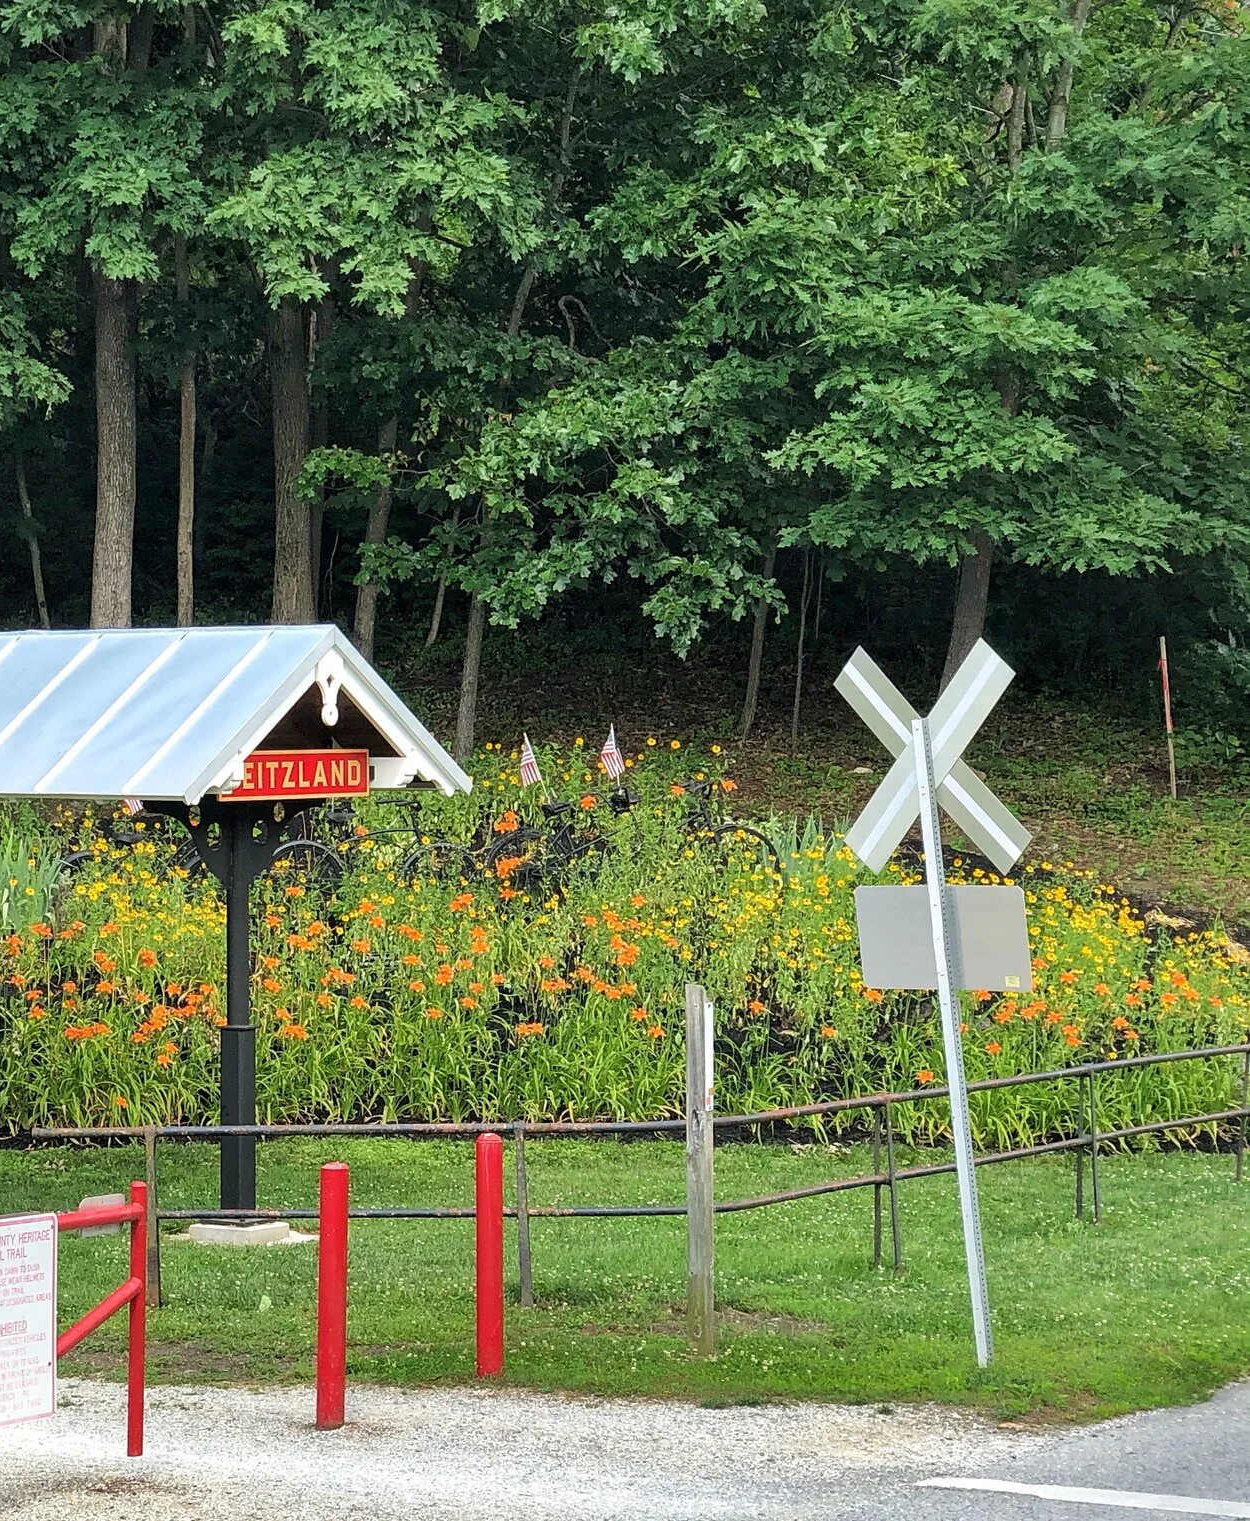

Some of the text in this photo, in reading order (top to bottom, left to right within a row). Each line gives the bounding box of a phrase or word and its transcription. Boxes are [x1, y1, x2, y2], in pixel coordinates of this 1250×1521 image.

[242, 760, 361, 790] EITZLAND
[18, 1229, 51, 1245] HERITAGE
[6, 1247, 27, 1260] TRAIL
[4, 1266, 18, 1276] DAWN
[20, 1265, 27, 1273] TO
[27, 1263, 41, 1272] DUSK
[8, 1275, 23, 1285] WEAR
[23, 1273, 45, 1283] HELMETS
[11, 1286, 25, 1295] TRAIL
[0, 1298, 5, 1308] AT
[6, 1294, 35, 1308] DESIGNATED
[35, 1291, 52, 1302] AREAS
